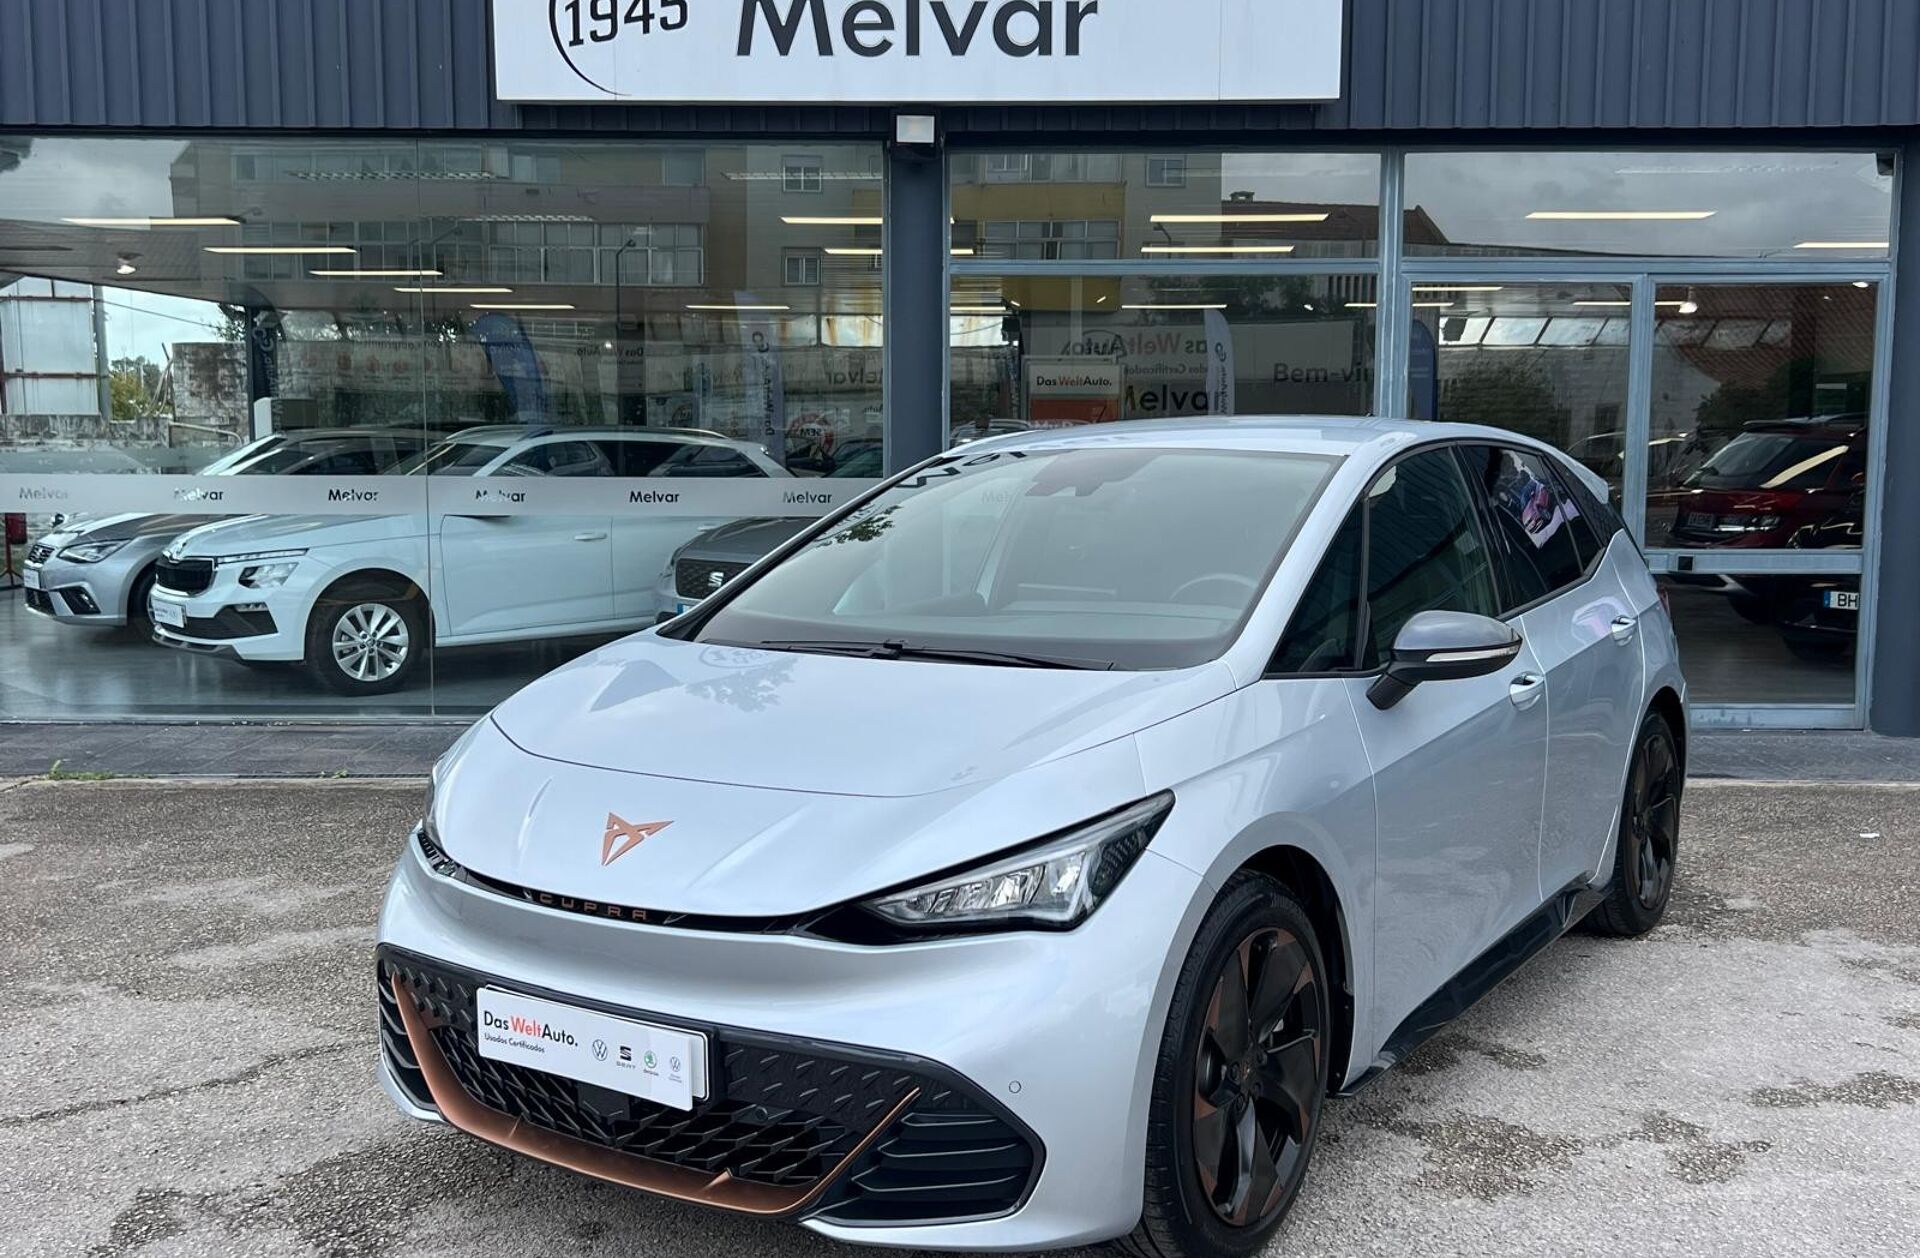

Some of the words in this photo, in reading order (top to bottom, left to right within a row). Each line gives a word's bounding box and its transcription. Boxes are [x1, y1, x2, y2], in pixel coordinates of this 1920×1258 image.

[564, 0, 688, 47] 1945
[736, 0, 1098, 57] Melvar
[1036, 375, 1057, 387] Das
[328, 489, 379, 502] Melvar
[475, 489, 526, 502] Mvar
[629, 490, 680, 503] Melvar
[782, 491, 833, 504] Melvar
[1837, 593, 1858, 608] BH
[539, 892, 647, 921] CUPRA
[483, 1010, 510, 1031] Das
[510, 1014, 579, 1048] WeltAuto.
[483, 1032, 508, 1046] Usados
[508, 1036, 545, 1053] Certificados
